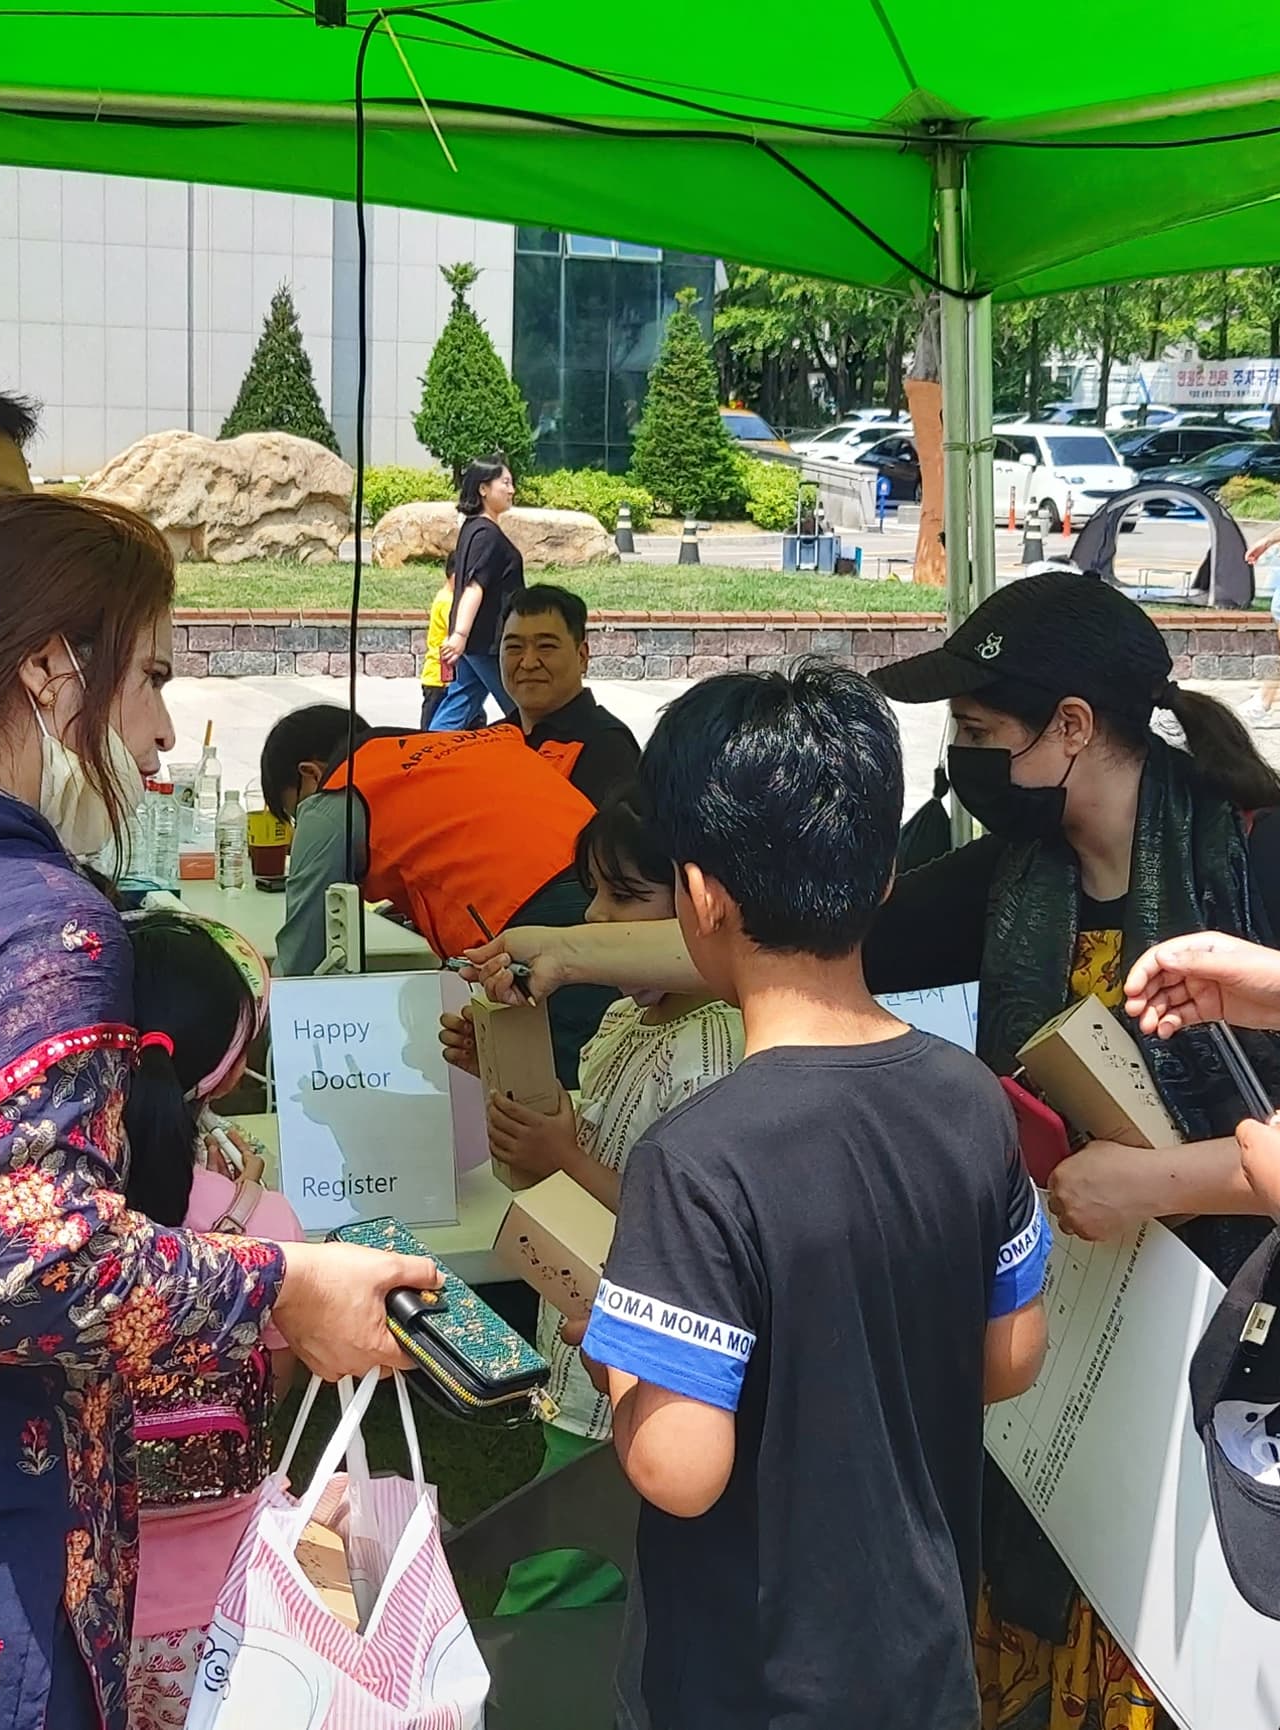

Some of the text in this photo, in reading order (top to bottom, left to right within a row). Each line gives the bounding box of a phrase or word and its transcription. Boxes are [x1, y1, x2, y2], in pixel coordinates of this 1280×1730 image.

[294, 1019, 370, 1044] Happy
[311, 1070, 391, 1091] Doctor
[303, 1173, 398, 1201] Register
[997, 1233, 1033, 1267] OMA
[660, 1309, 722, 1346] MOMA
[726, 1331, 754, 1358] MO
